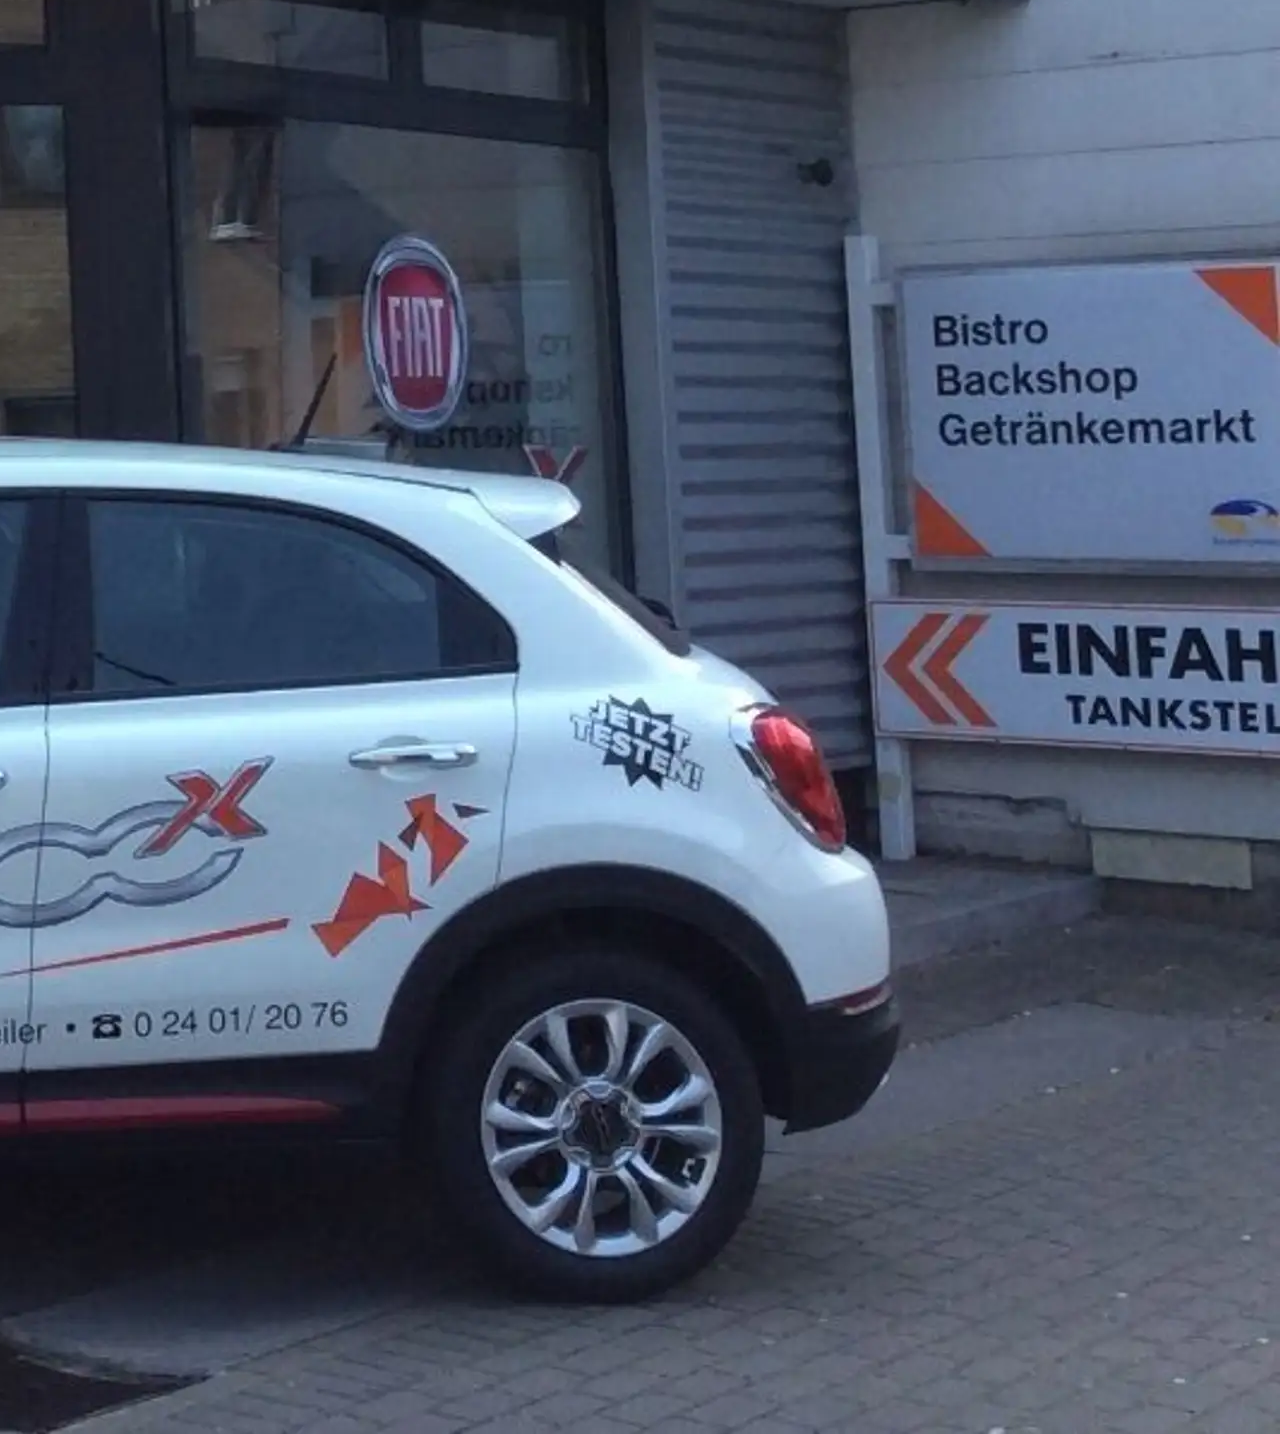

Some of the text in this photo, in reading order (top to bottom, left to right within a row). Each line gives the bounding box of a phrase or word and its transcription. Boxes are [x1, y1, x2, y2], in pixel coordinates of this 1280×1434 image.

[386, 295, 445, 379] FIAT
[932, 314, 1049, 348] Bistro
[936, 362, 1139, 400] Backshop
[938, 408, 1257, 447] Getränkemarkt
[1016, 621, 1279, 684] EINFAH
[589, 697, 692, 750] JETZT
[1065, 693, 1280, 735] TANKSTEL
[570, 713, 706, 792] TESTEN!
[134, 1011, 152, 1037] 0
[161, 1009, 198, 1036] 24
[310, 1000, 350, 1028] 76
